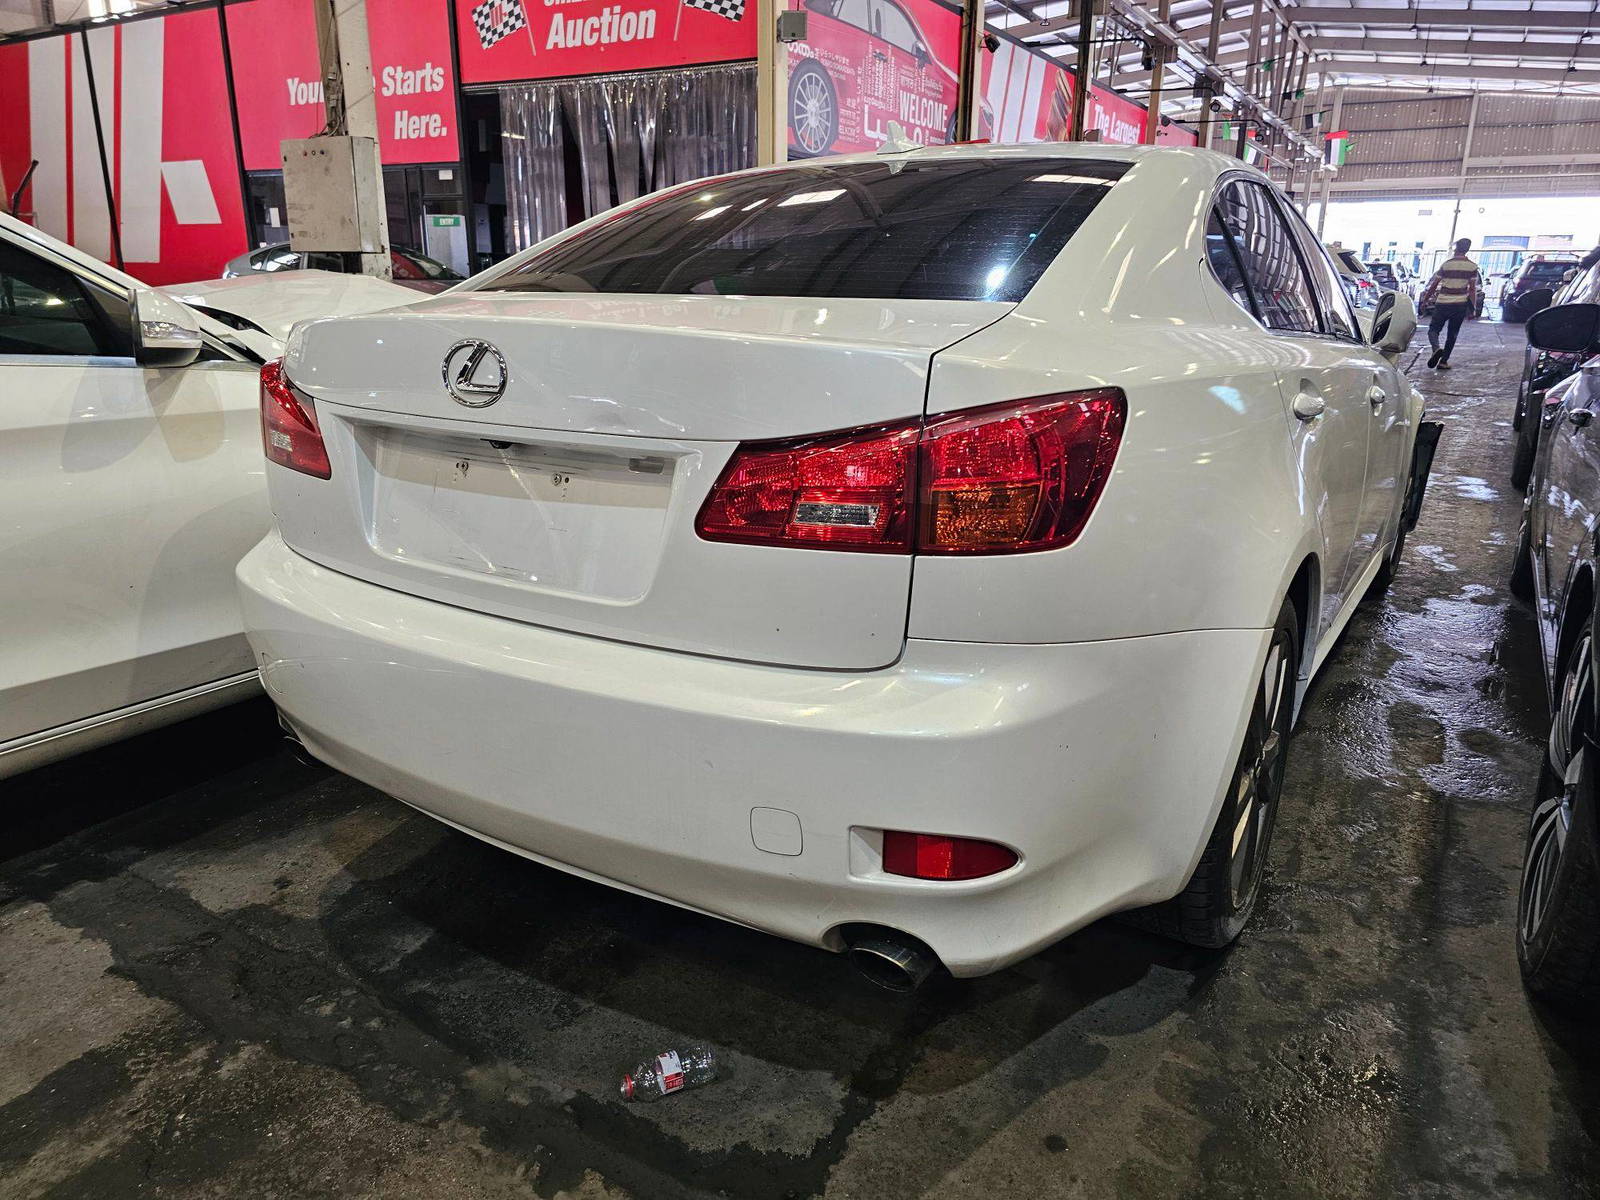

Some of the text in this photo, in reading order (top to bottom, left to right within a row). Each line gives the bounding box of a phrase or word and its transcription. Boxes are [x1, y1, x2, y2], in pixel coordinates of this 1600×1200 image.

[546, 6, 656, 50] Auction
[381, 62, 445, 97] Starts
[394, 110, 448, 140] Here.
[899, 89, 948, 133] WELCOME
[1094, 103, 1141, 144] The Largest
